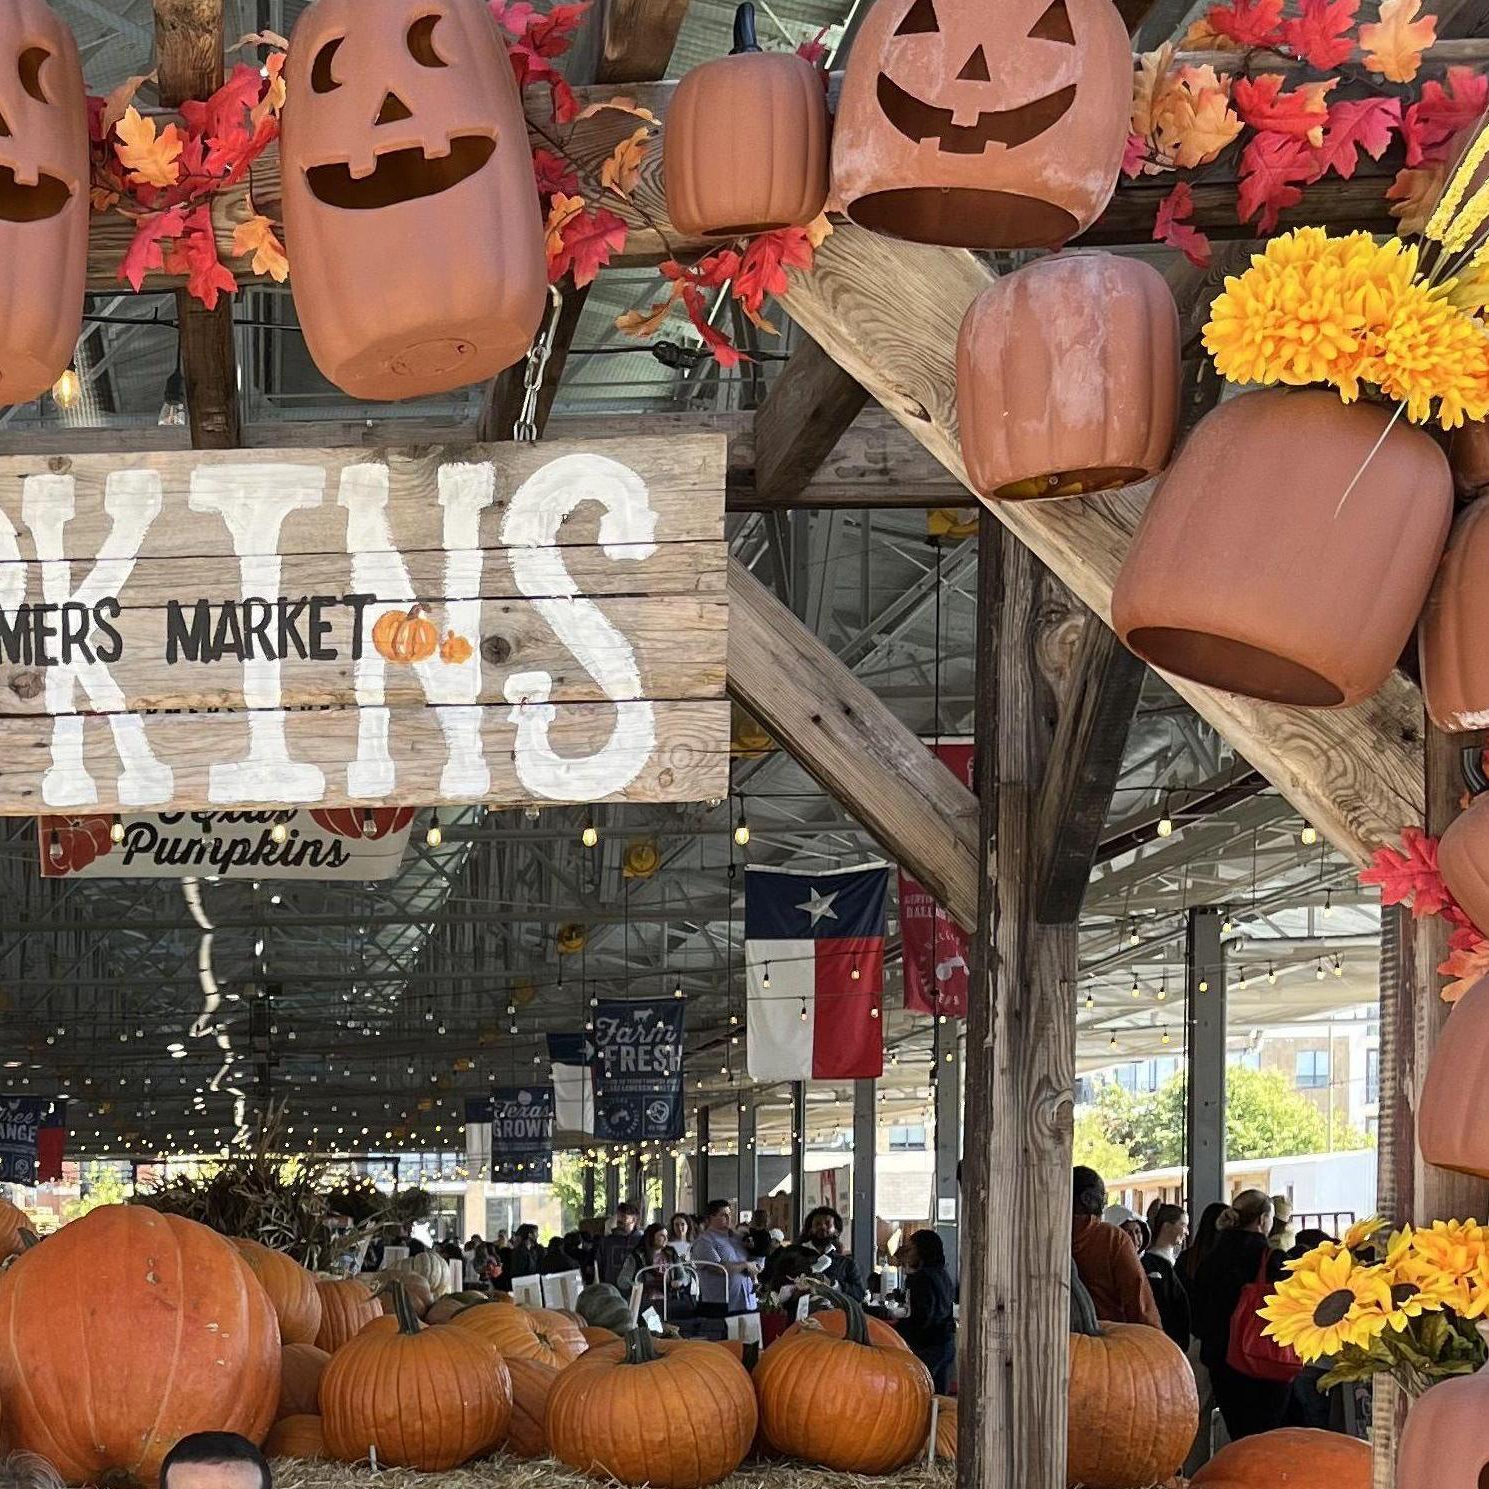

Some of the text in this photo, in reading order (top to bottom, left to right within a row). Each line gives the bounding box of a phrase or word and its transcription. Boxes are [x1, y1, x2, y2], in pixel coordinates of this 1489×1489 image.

[166, 594, 376, 663] MARKET
[122, 820, 350, 874] Pumpkins
[595, 1017, 678, 1045] Farm
[604, 1044, 683, 1073] FRESH
[494, 1100, 553, 1119] Texas
[493, 1119, 553, 1138] GROWN
